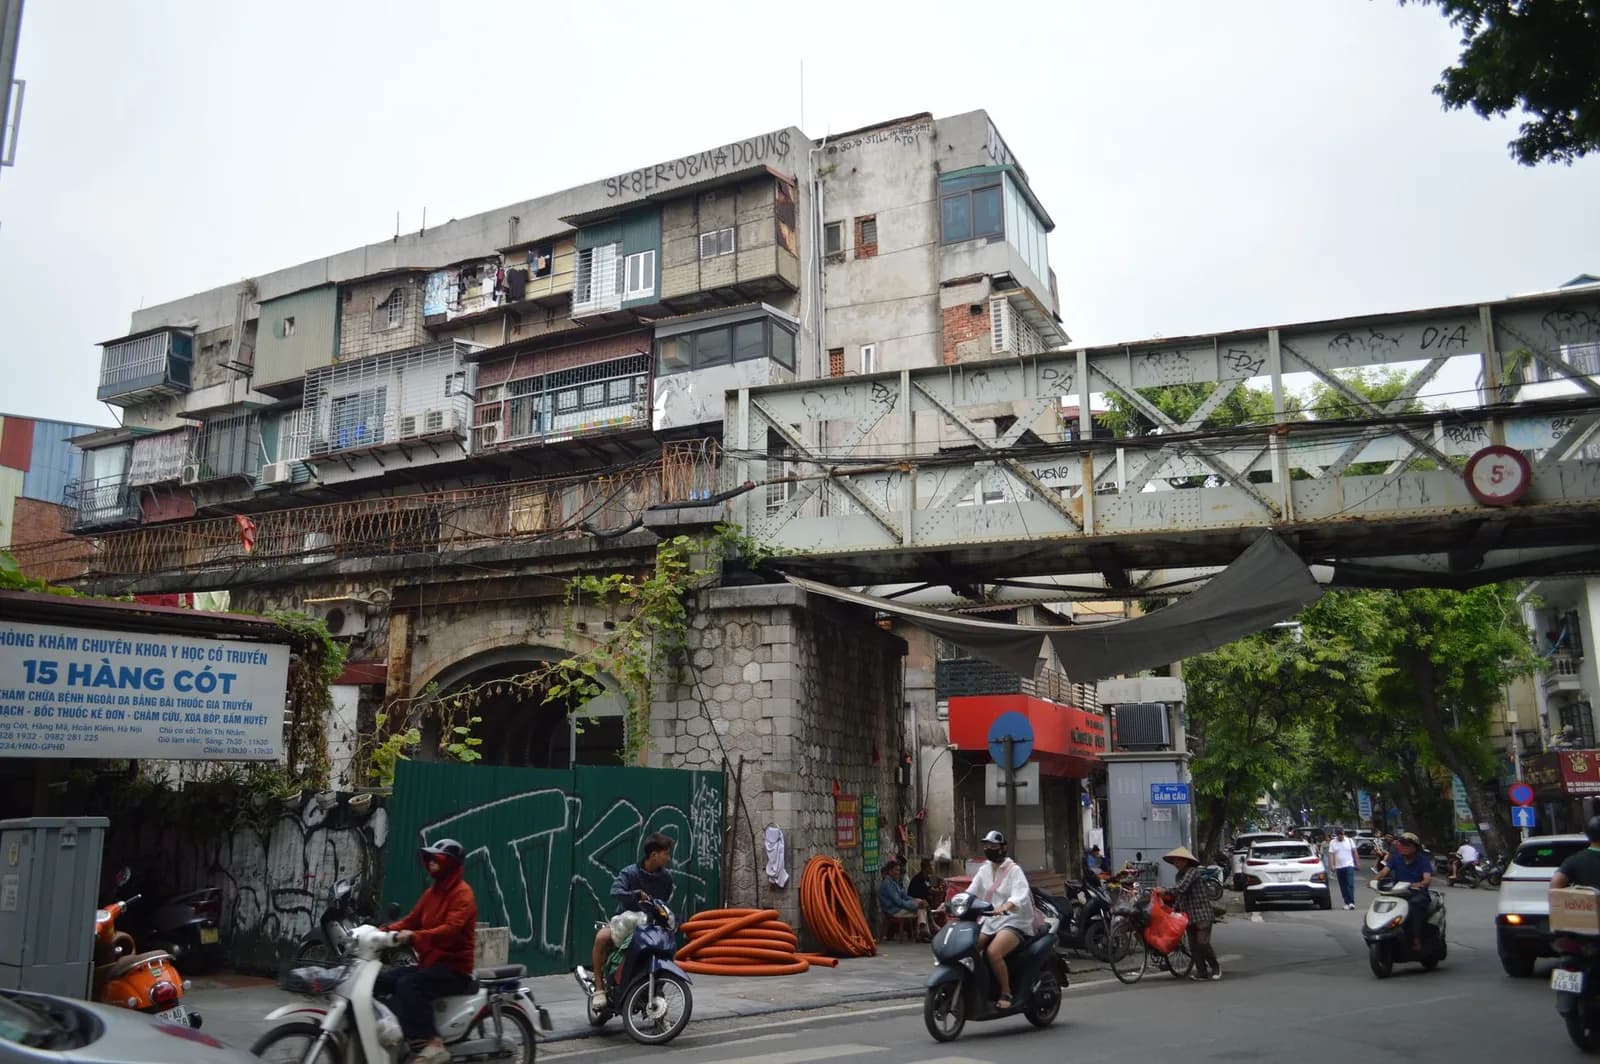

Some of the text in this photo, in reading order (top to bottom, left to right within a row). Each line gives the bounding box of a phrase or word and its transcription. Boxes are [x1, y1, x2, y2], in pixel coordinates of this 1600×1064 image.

[1491, 464, 1504, 484] 5
[38, 633, 78, 651] KHÁM
[82, 638, 131, 655] CHUYÊN
[135, 643, 167, 658] KHOA
[171, 645, 178, 658] Y
[181, 646, 204, 663] HỌC
[208, 644, 223, 661] CỔ
[227, 648, 268, 665] TRUYỀN
[23, 657, 237, 694] 15 HÀNG CÓT
[0, 688, 25, 701] HÁM
[28, 688, 55, 701] CHỮA
[58, 690, 84, 704] BỆNH
[86, 692, 115, 705] NGOÀI
[118, 695, 130, 706] DA
[206, 699, 220, 710] GIA
[185, 713, 201, 722] XOA
